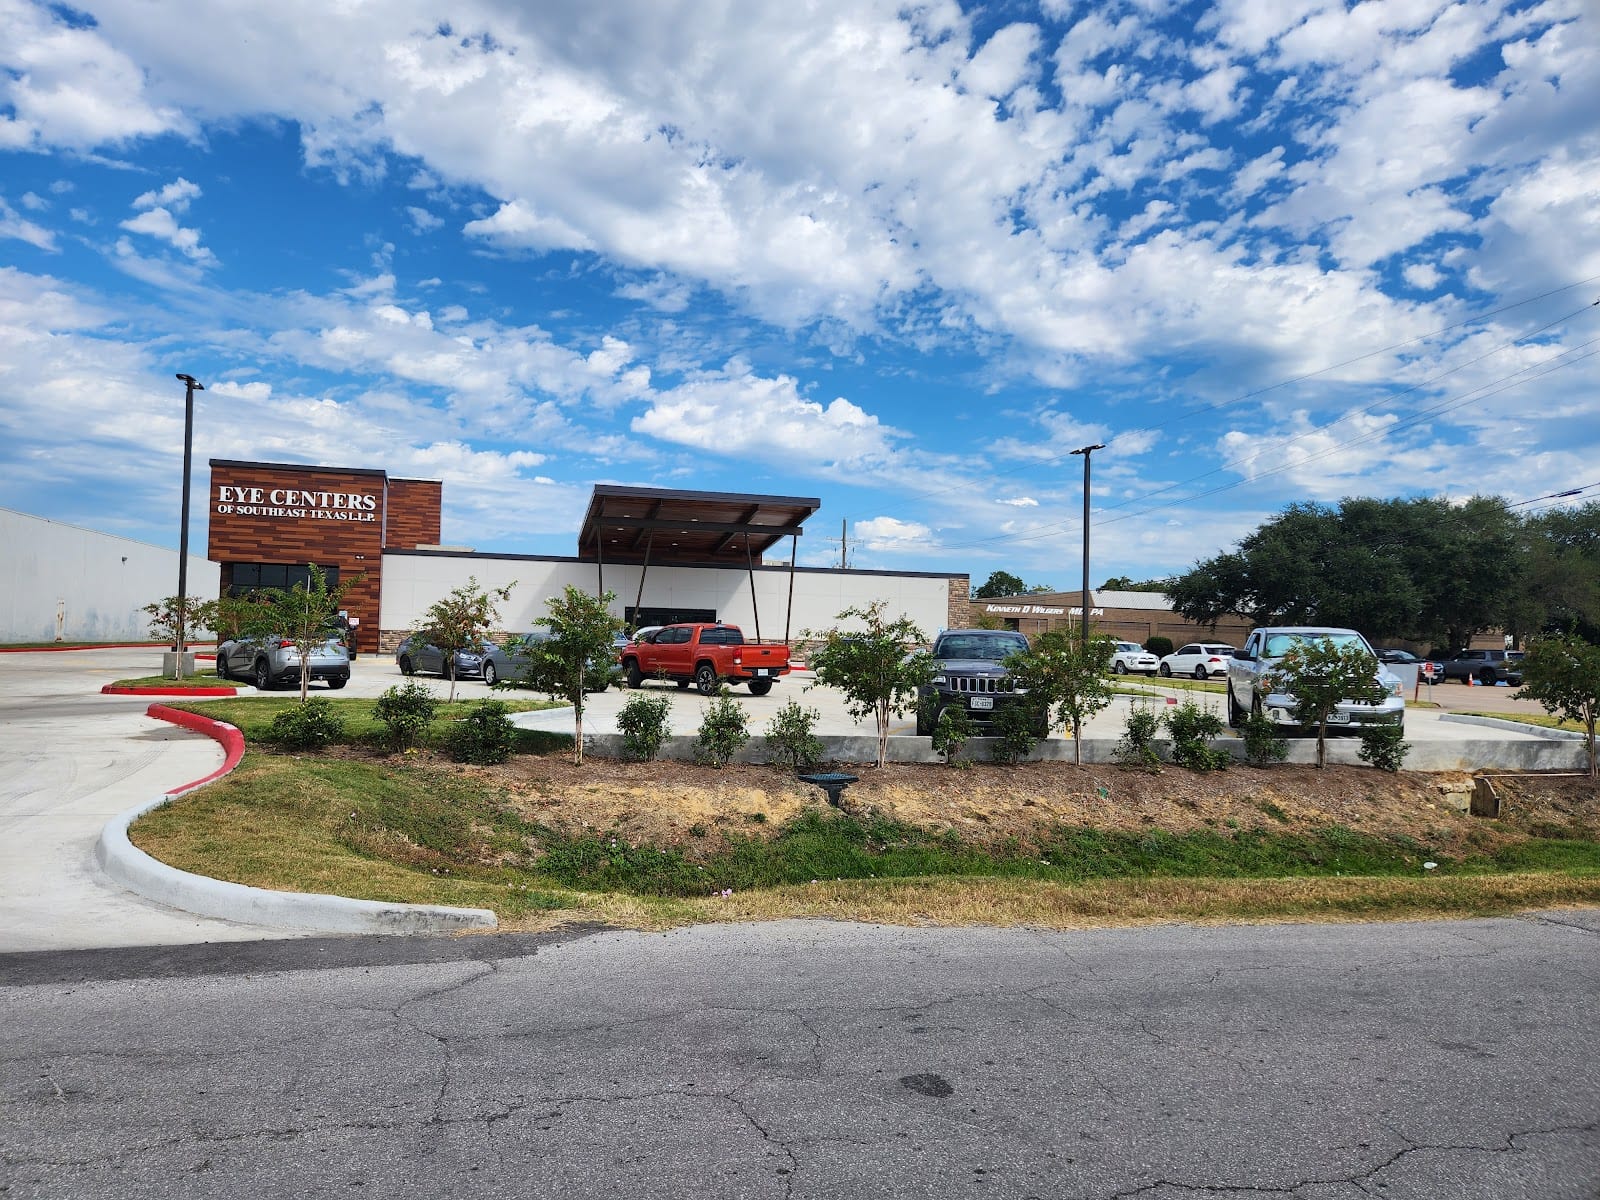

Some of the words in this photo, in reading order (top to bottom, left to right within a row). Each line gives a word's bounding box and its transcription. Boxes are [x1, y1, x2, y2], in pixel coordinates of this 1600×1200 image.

[218, 486, 264, 504] EYE
[270, 489, 376, 511] CENTERS
[217, 504, 234, 514] OF
[236, 505, 307, 518] SOUTHEAST
[310, 509, 347, 520] TEXAS
[348, 511, 376, 522] L.L.P.
[1090, 608, 1104, 616] PA
